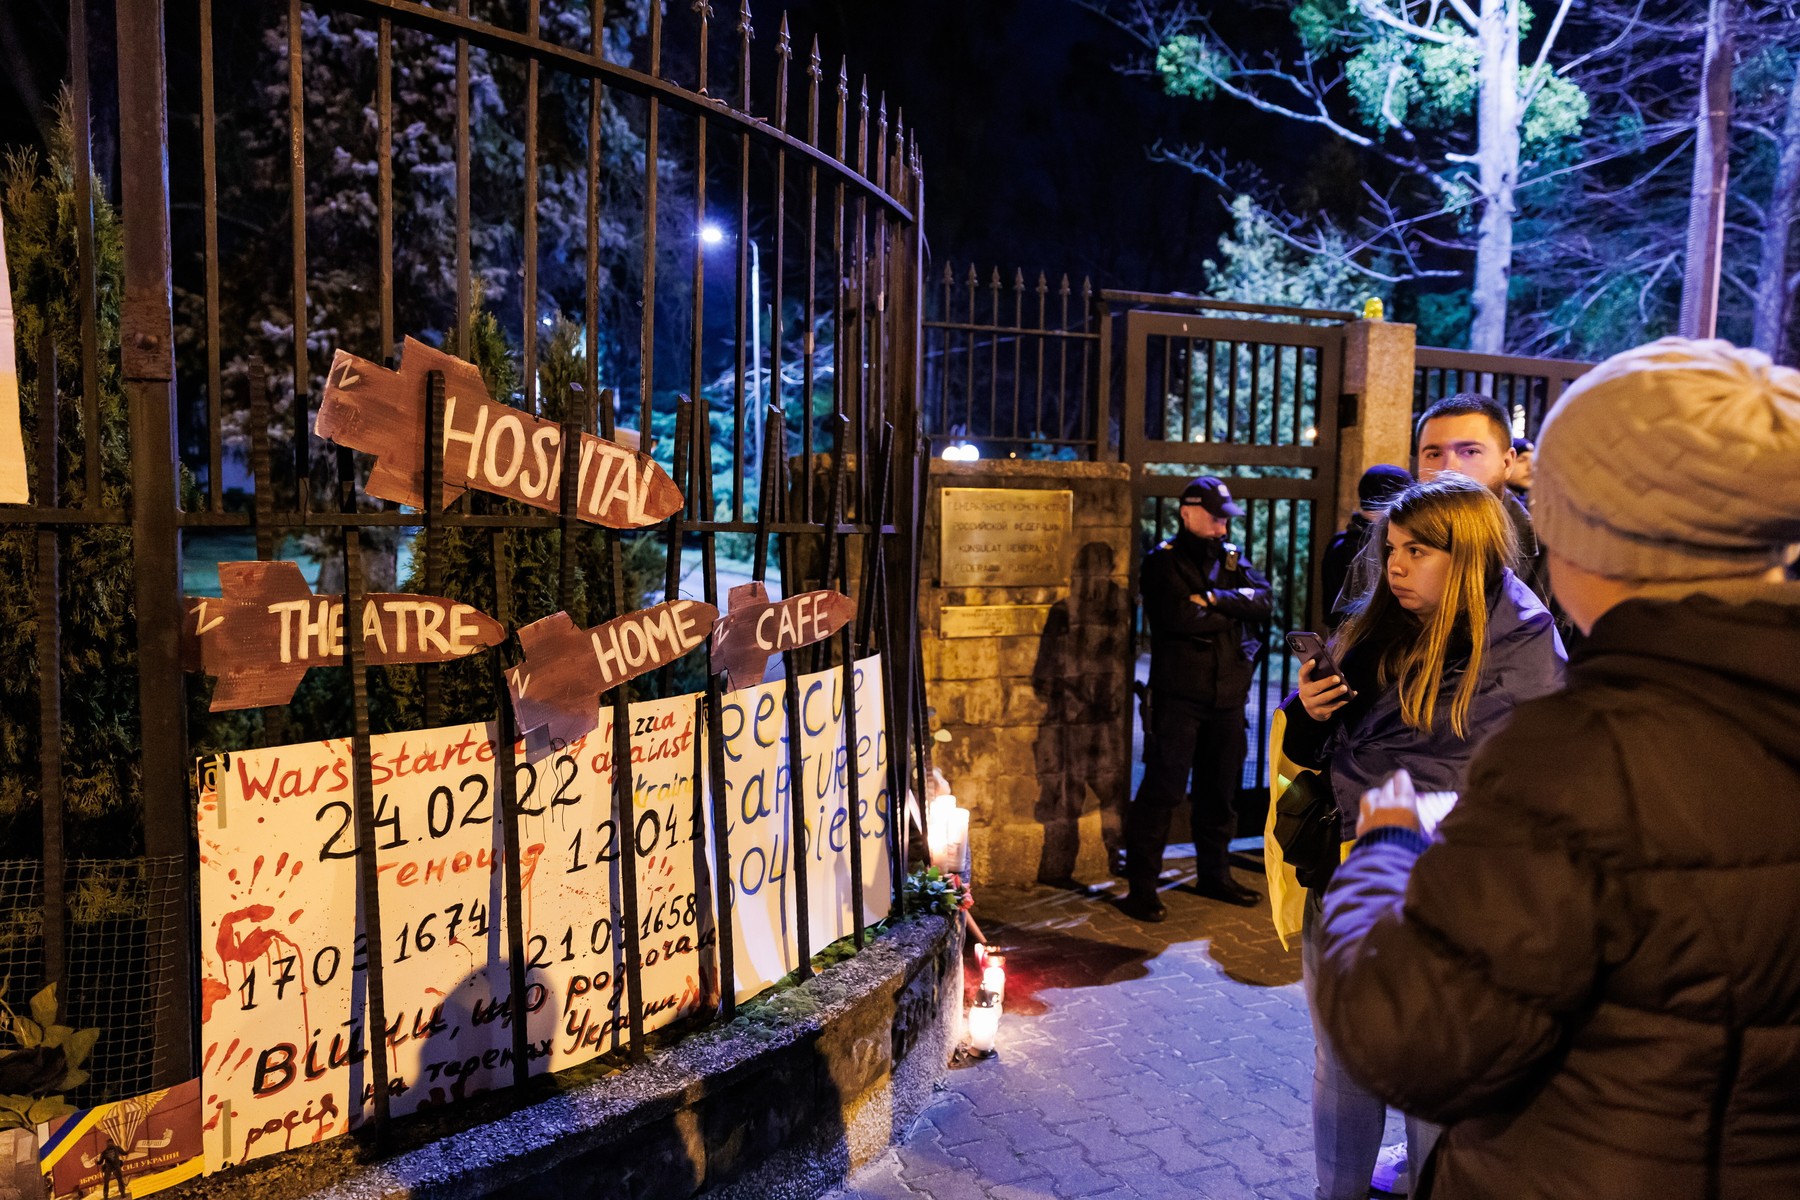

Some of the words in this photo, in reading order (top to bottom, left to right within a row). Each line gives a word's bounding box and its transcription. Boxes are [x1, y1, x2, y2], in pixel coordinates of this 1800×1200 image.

[1007, 543, 1055, 553] GENERA
[268, 599, 487, 663] THEATRE
[591, 600, 702, 684] HOME
[756, 592, 829, 651] CAFE
[237, 756, 349, 801] Wars
[604, 710, 677, 744] rzzia
[376, 843, 545, 891] геноцд
[563, 927, 716, 1018] розочала
[563, 994, 678, 1055] Украни
